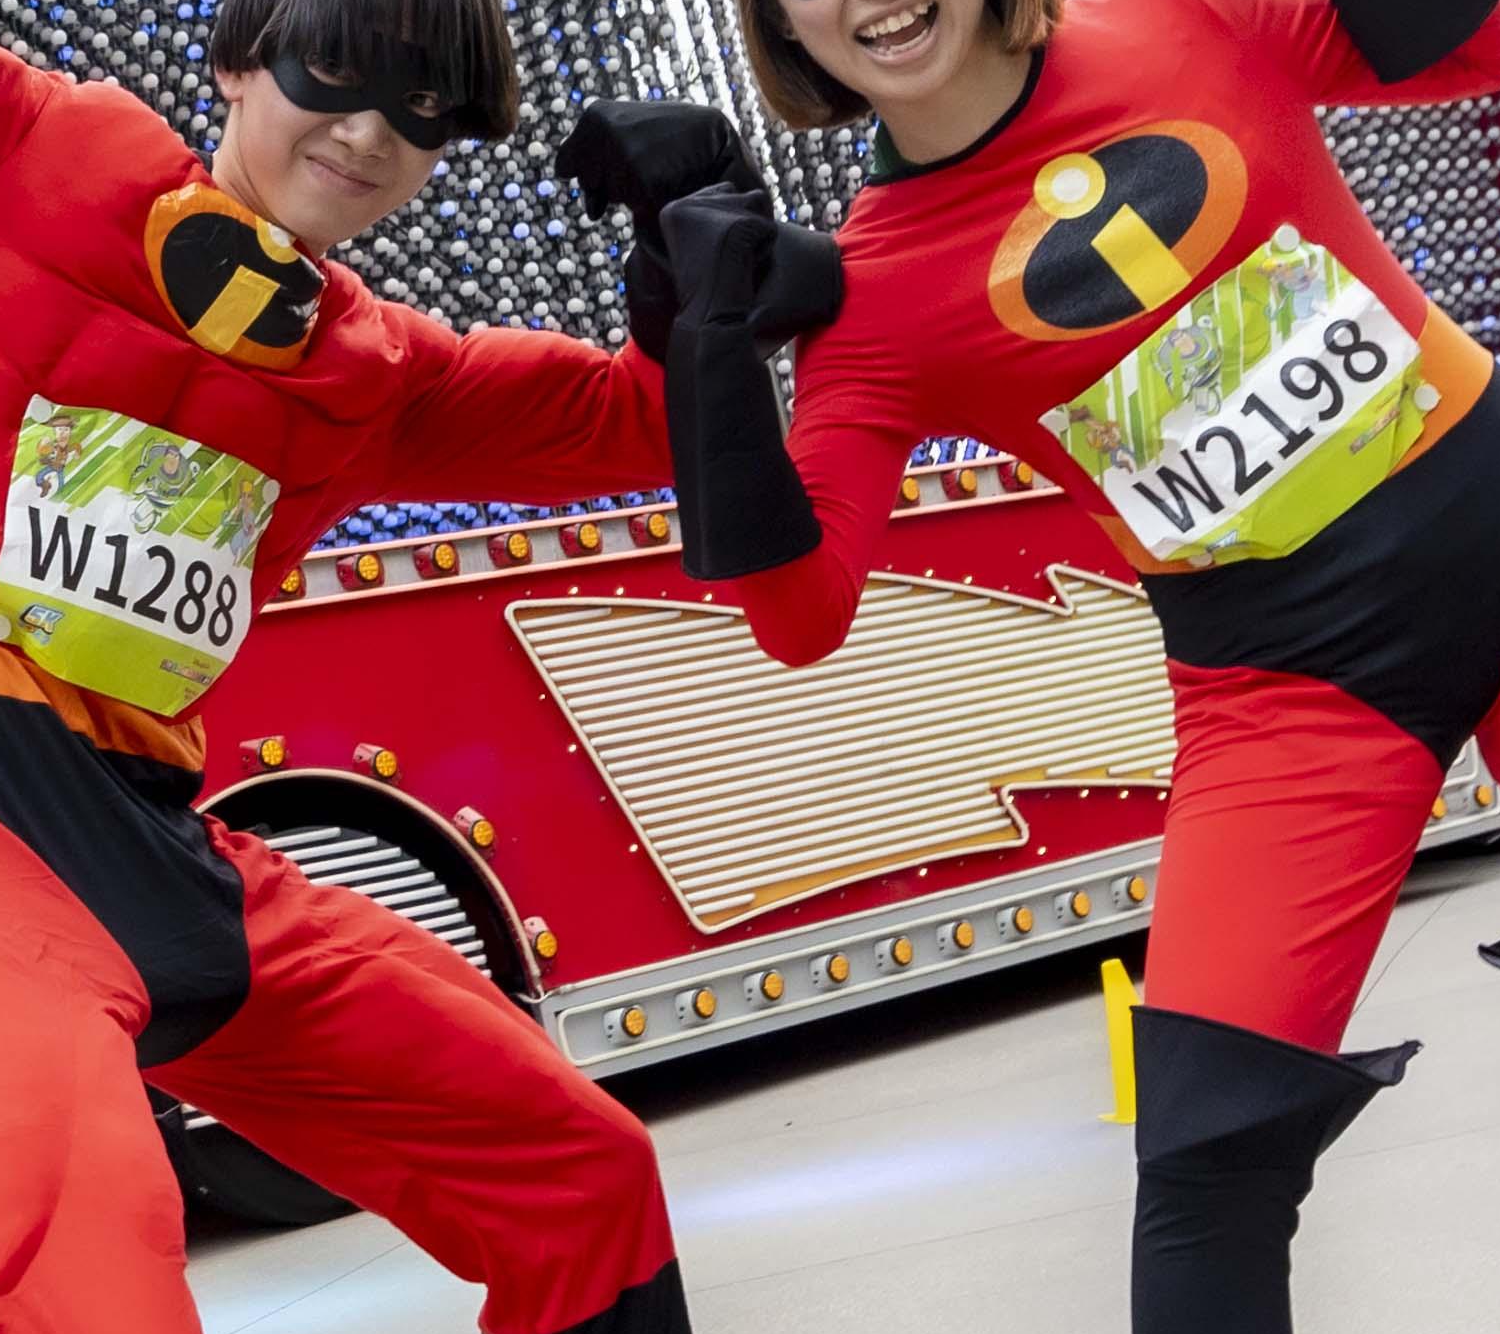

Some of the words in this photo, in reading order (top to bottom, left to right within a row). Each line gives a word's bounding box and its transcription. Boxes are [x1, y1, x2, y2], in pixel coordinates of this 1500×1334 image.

[1132, 319, 1388, 534] W2198
[20, 604, 65, 635] 5K
[28, 505, 237, 647] W1288
